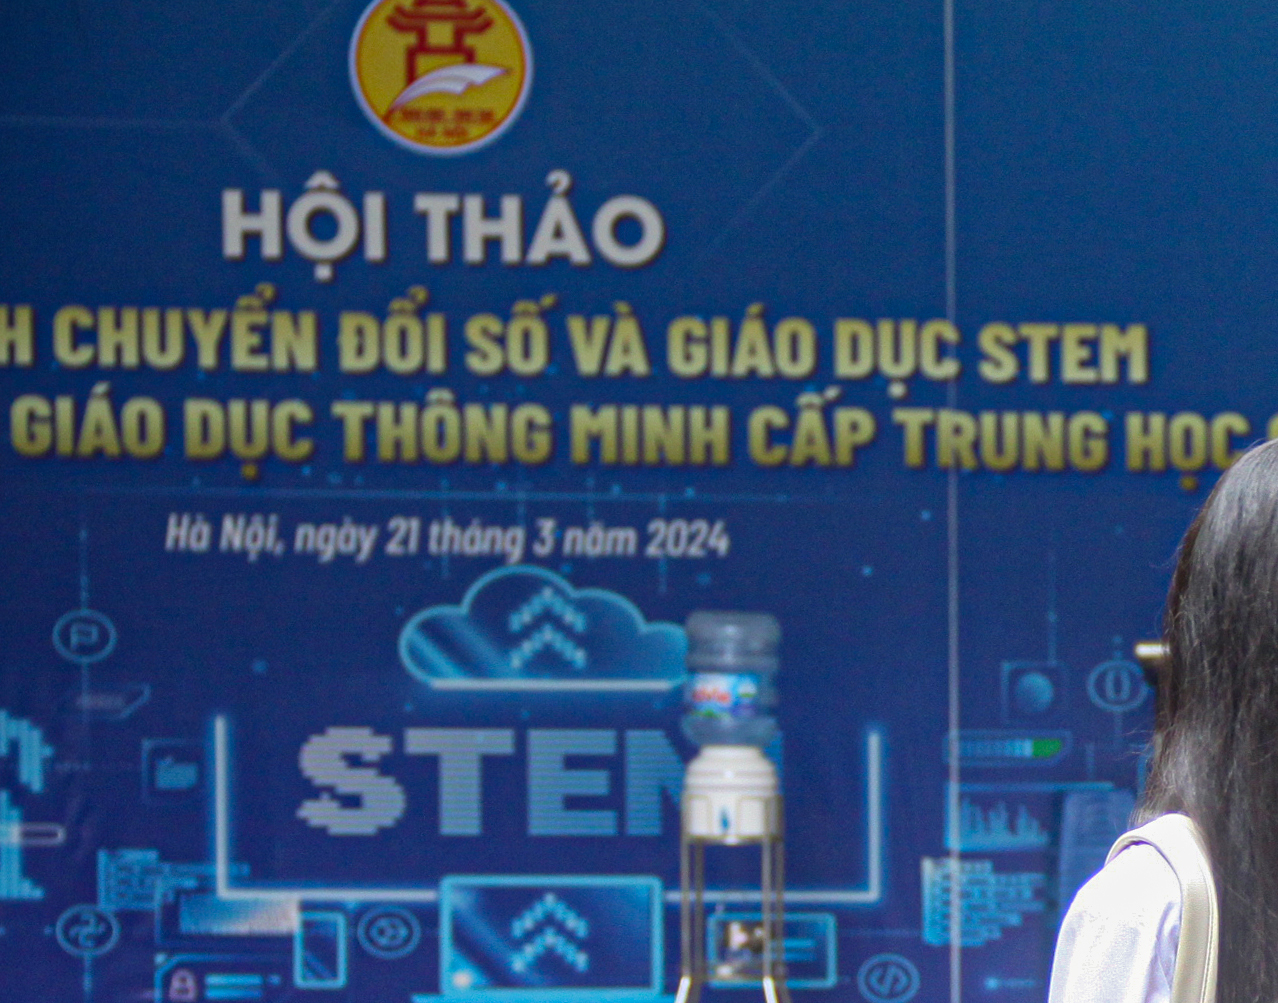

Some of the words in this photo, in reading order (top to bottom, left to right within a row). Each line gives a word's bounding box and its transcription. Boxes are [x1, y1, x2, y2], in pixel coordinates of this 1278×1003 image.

[221, 171, 386, 281] HỘI
[414, 170, 665, 266] THẢO
[52, 284, 318, 371] CHUYỂN
[338, 286, 448, 374] ĐỔI
[465, 295, 557, 376] SỐ
[567, 302, 650, 377] VÀ
[667, 303, 815, 378] GIÁO
[834, 317, 960, 398] DỤC
[979, 323, 1149, 384] STEM
[10, 383, 164, 457] GIÁO
[185, 398, 314, 480] DỤC
[332, 390, 553, 464] THÔNG
[571, 405, 731, 465] MINH
[748, 386, 876, 467] CẤP
[893, 408, 1107, 472] TRUNG
[1124, 411, 1249, 491] HỌC
[165, 513, 212, 551] Hà
[220, 514, 283, 562] Nội,
[294, 520, 377, 563] ngày
[386, 517, 420, 555] 21
[428, 520, 525, 565] tháng
[532, 518, 556, 557] 3
[563, 523, 637, 557] năm
[645, 518, 731, 558] 2024
